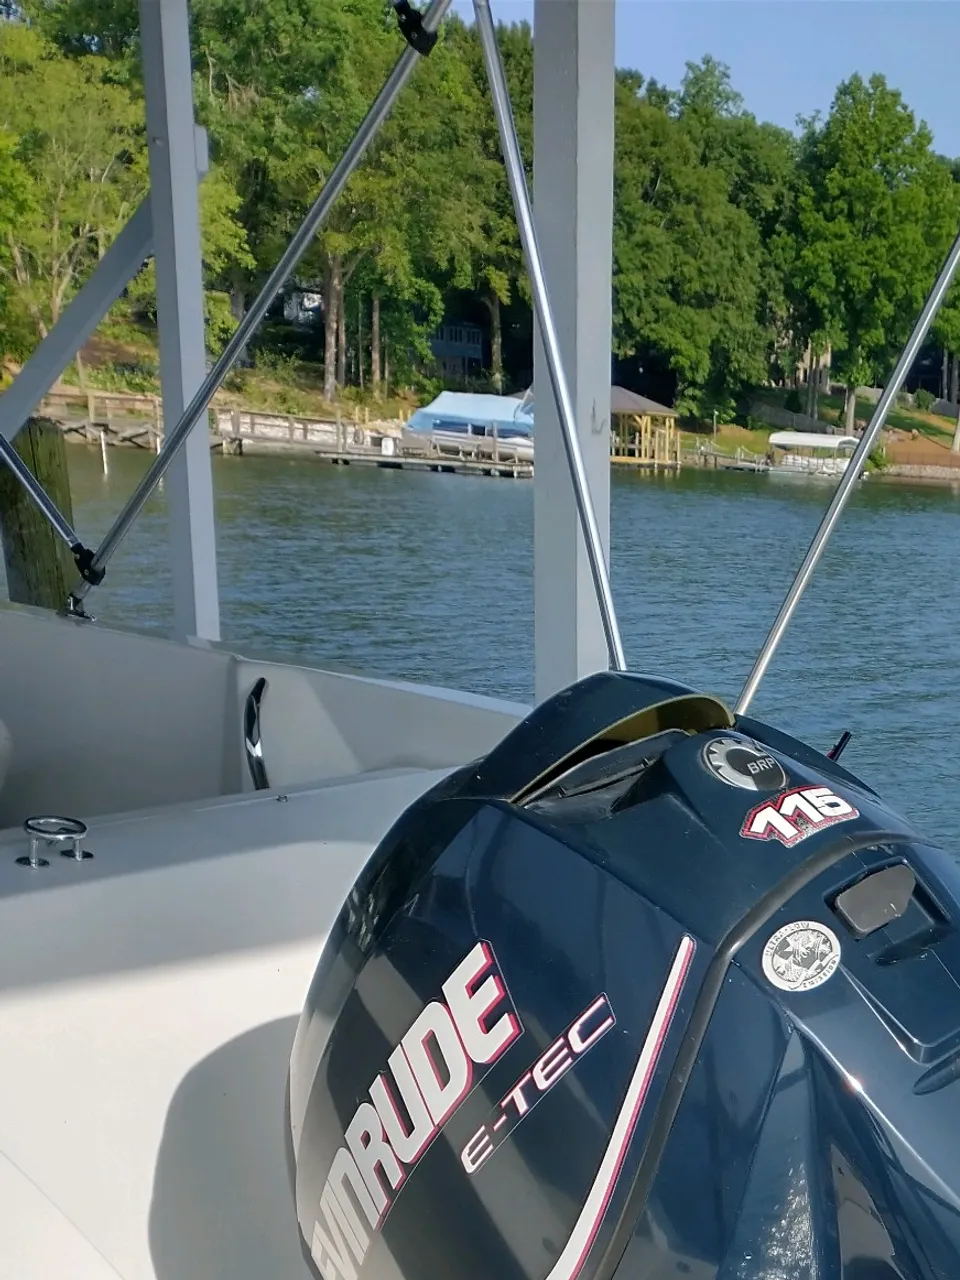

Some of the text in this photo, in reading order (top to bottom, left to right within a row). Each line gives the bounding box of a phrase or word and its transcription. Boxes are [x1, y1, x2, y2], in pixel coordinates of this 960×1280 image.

[746, 756, 777, 776] BRP
[743, 786, 859, 846] 115
[460, 994, 615, 1174] E-TEC
